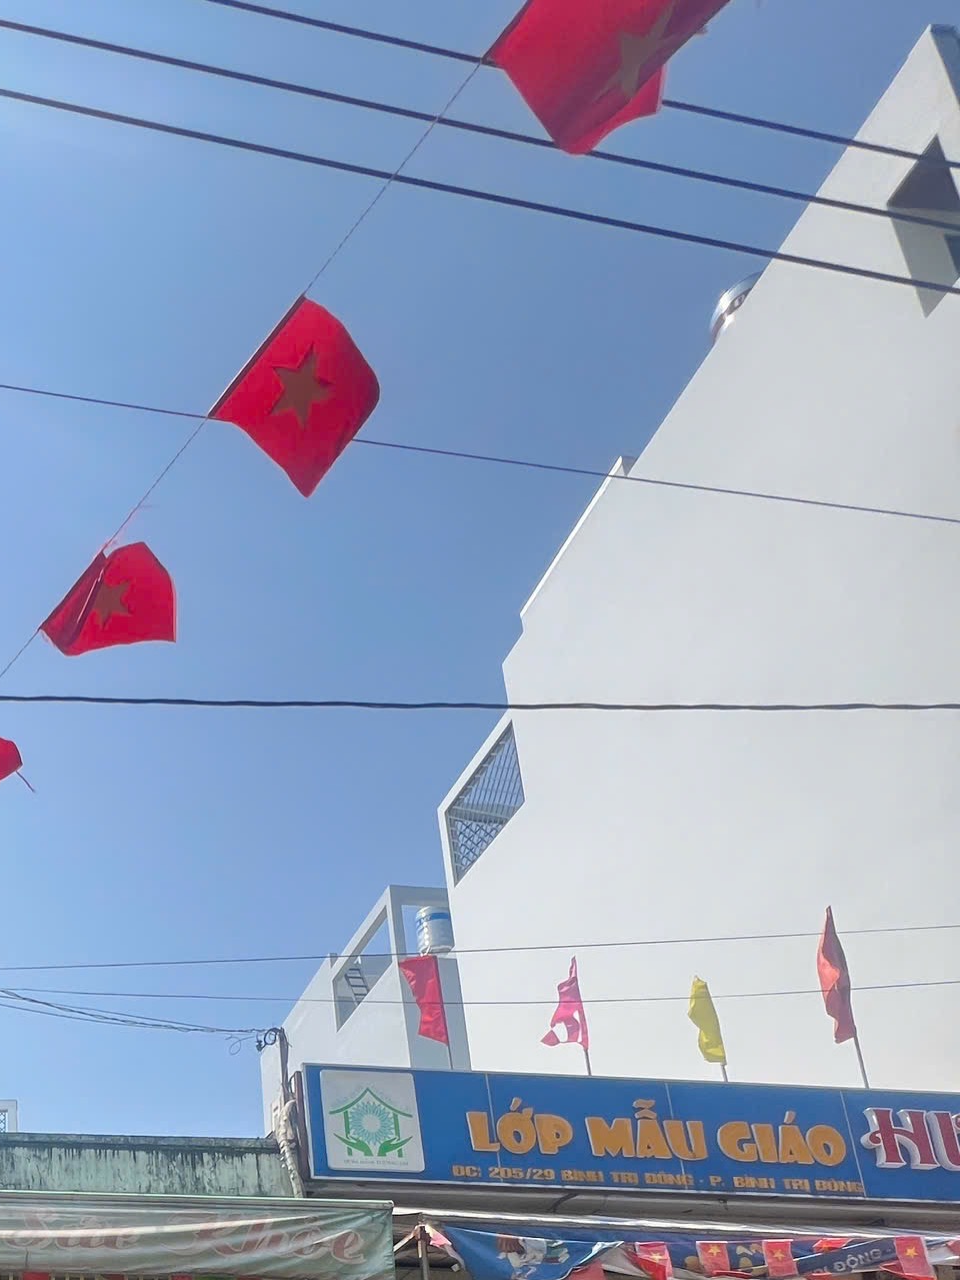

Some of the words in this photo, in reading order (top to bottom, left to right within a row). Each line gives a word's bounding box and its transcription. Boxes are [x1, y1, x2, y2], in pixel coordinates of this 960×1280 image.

[465, 1097, 574, 1155] LỚP
[585, 1098, 708, 1161] MẪU
[716, 1110, 847, 1167] GIÁO
[488, 1166, 556, 1181] 205/29
